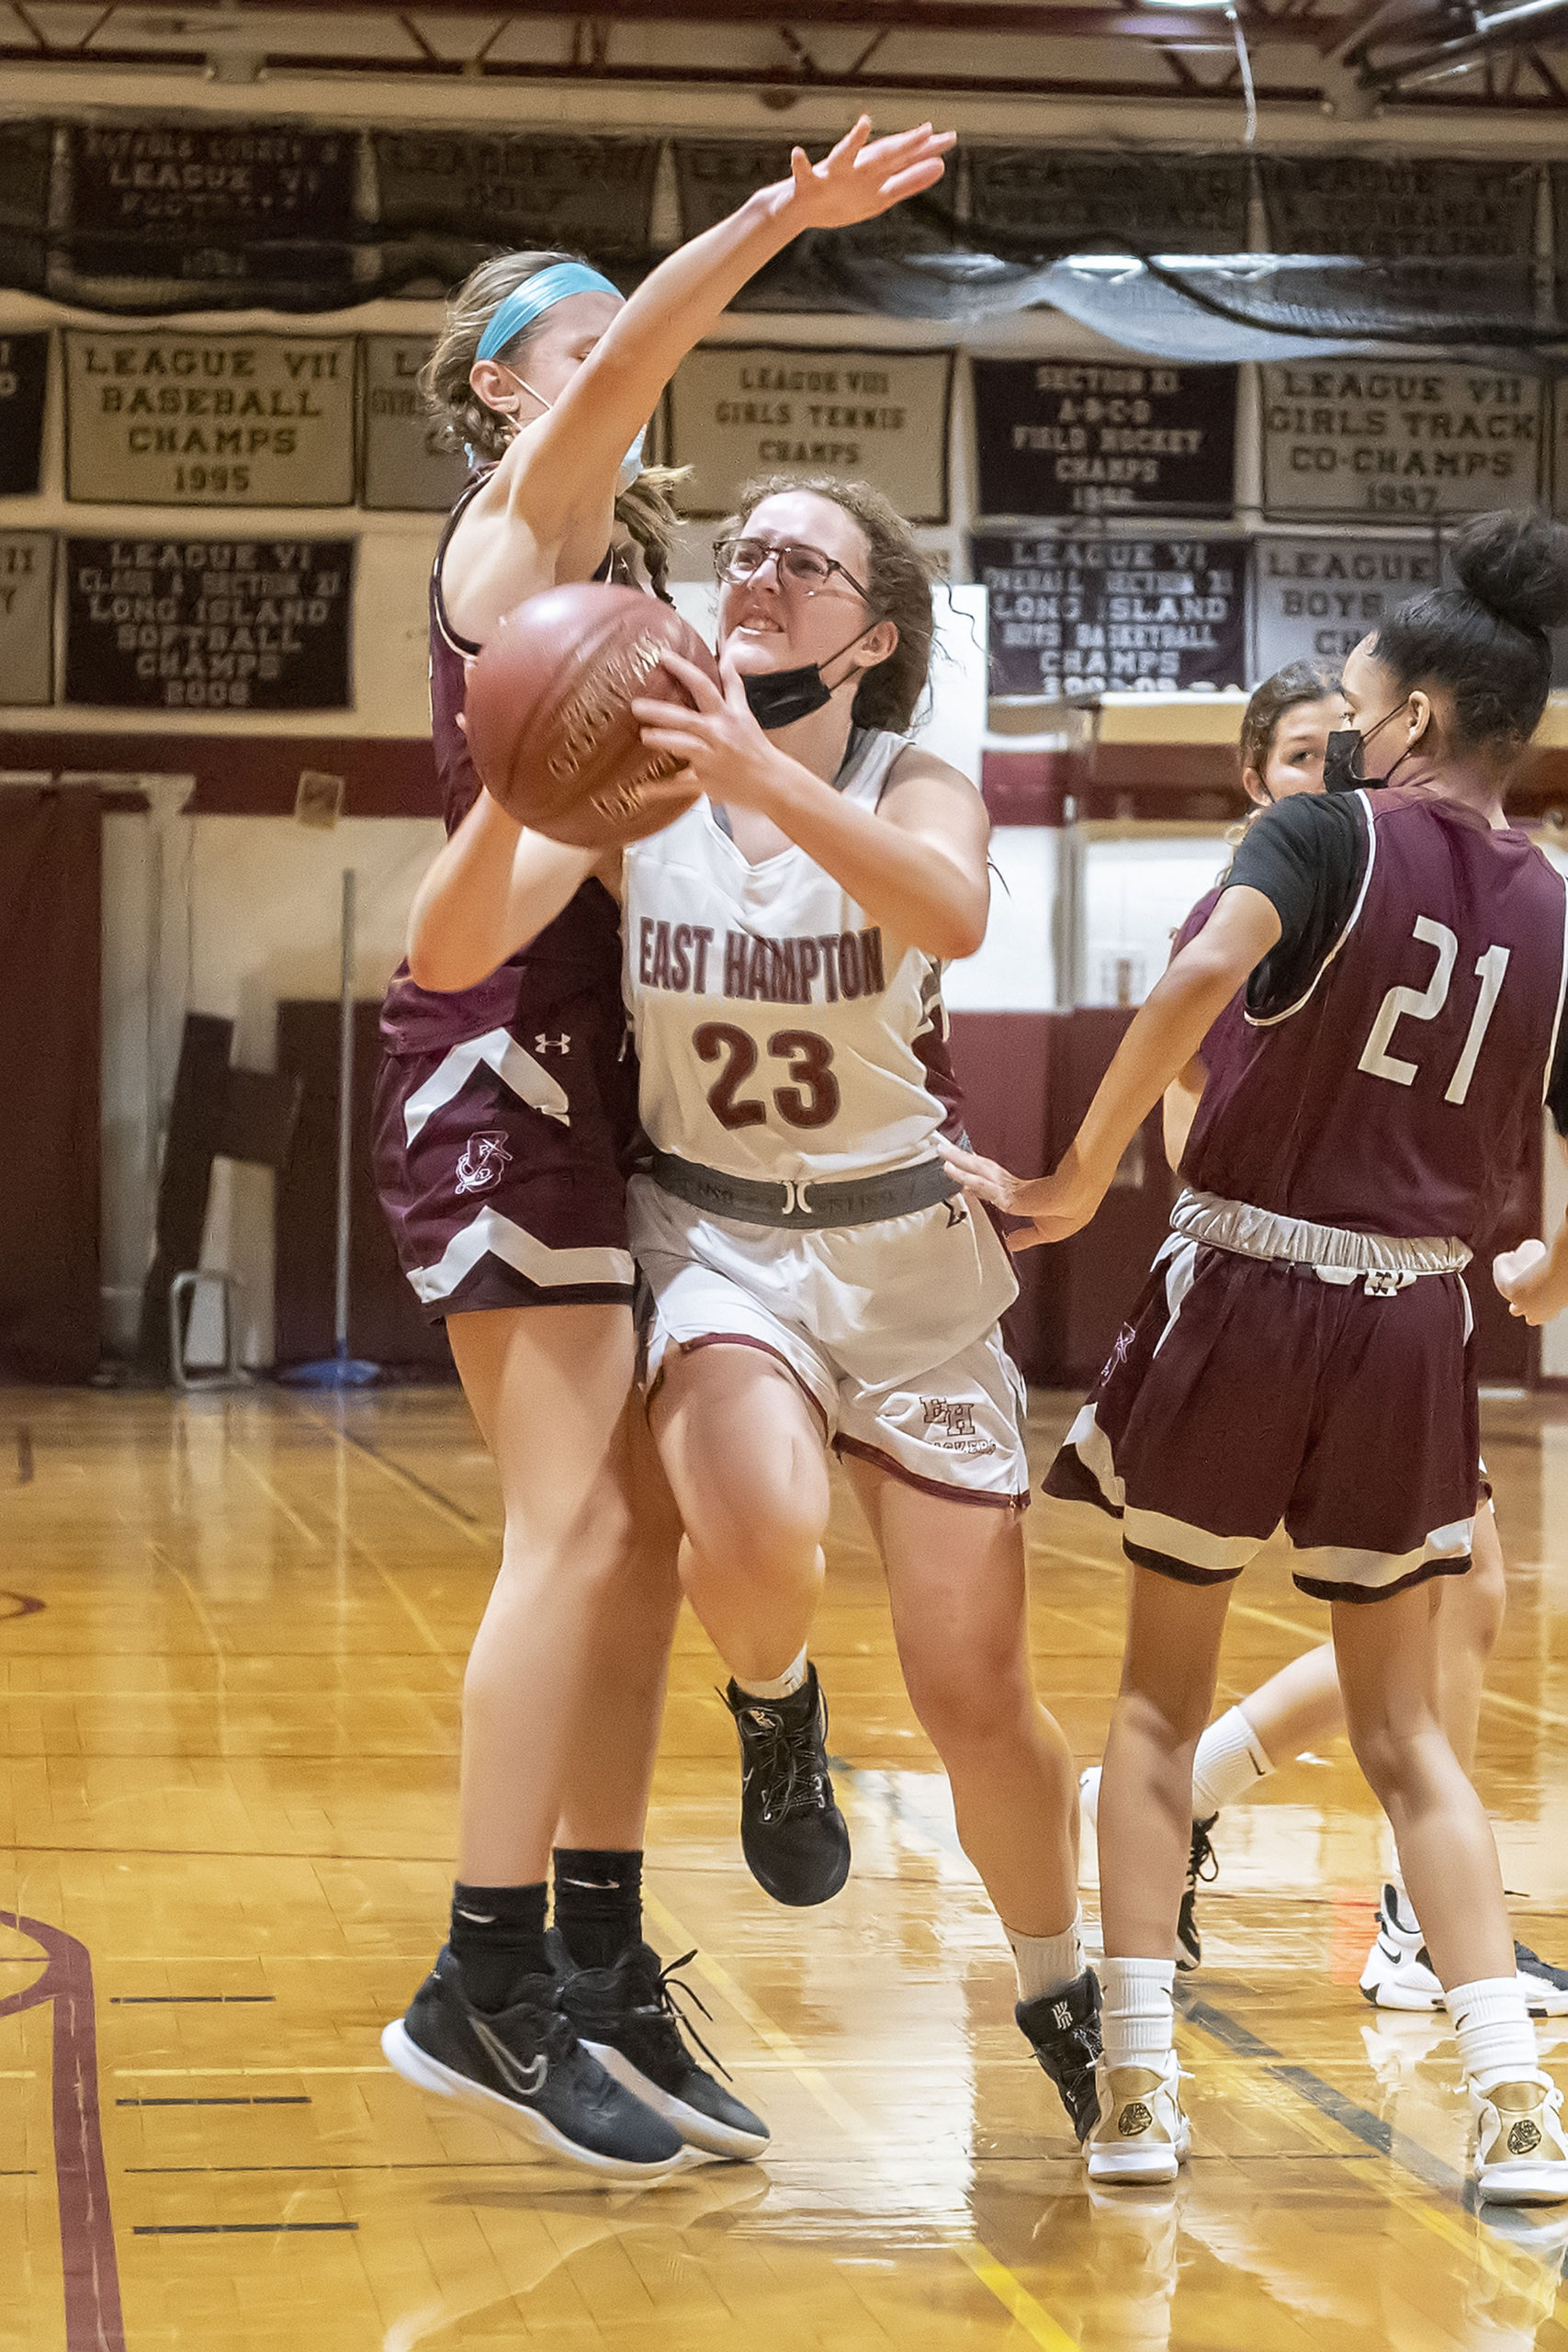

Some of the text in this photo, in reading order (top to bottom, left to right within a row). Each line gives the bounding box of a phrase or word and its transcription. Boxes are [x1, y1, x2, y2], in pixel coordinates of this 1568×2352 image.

[85, 347, 339, 379] LEAGUE VII
[739, 368, 838, 394] LEAGUE
[1035, 366, 1144, 393] SECTION
[1284, 371, 1522, 404] LEAGUE VII
[101, 385, 321, 418] BASEBALL
[715, 401, 906, 431] GIRLS TENNIS
[1265, 405, 1536, 441] GIRLS TRACK
[128, 426, 297, 455] CHAMPS
[757, 438, 862, 465] CHAMPS
[1013, 425, 1203, 454] FIELD HOCKEY
[1055, 457, 1160, 483] CHAMPS
[1289, 447, 1515, 479] CO-CHAMPS
[1366, 483, 1439, 508] 1997
[110, 542, 311, 571] LEAGUE VI
[1012, 541, 1208, 570] LEAGUE VI
[1268, 553, 1431, 582] LEAGUE
[201, 571, 299, 597] SECTION
[1105, 570, 1196, 595] SECTION
[88, 596, 330, 626] LONG ISLAND
[992, 595, 1230, 623] LONG ISLAND
[1281, 590, 1382, 618] BOYS
[117, 624, 303, 652] SOFTBALL
[1002, 621, 1222, 649] BOYS BASKETBALL
[135, 652, 281, 680] CHAMPS
[1038, 650, 1181, 676] CHAMPS
[638, 915, 886, 1005] EAST HAMPTON
[1357, 914, 1511, 1105] 21
[692, 1021, 840, 1132] 23
